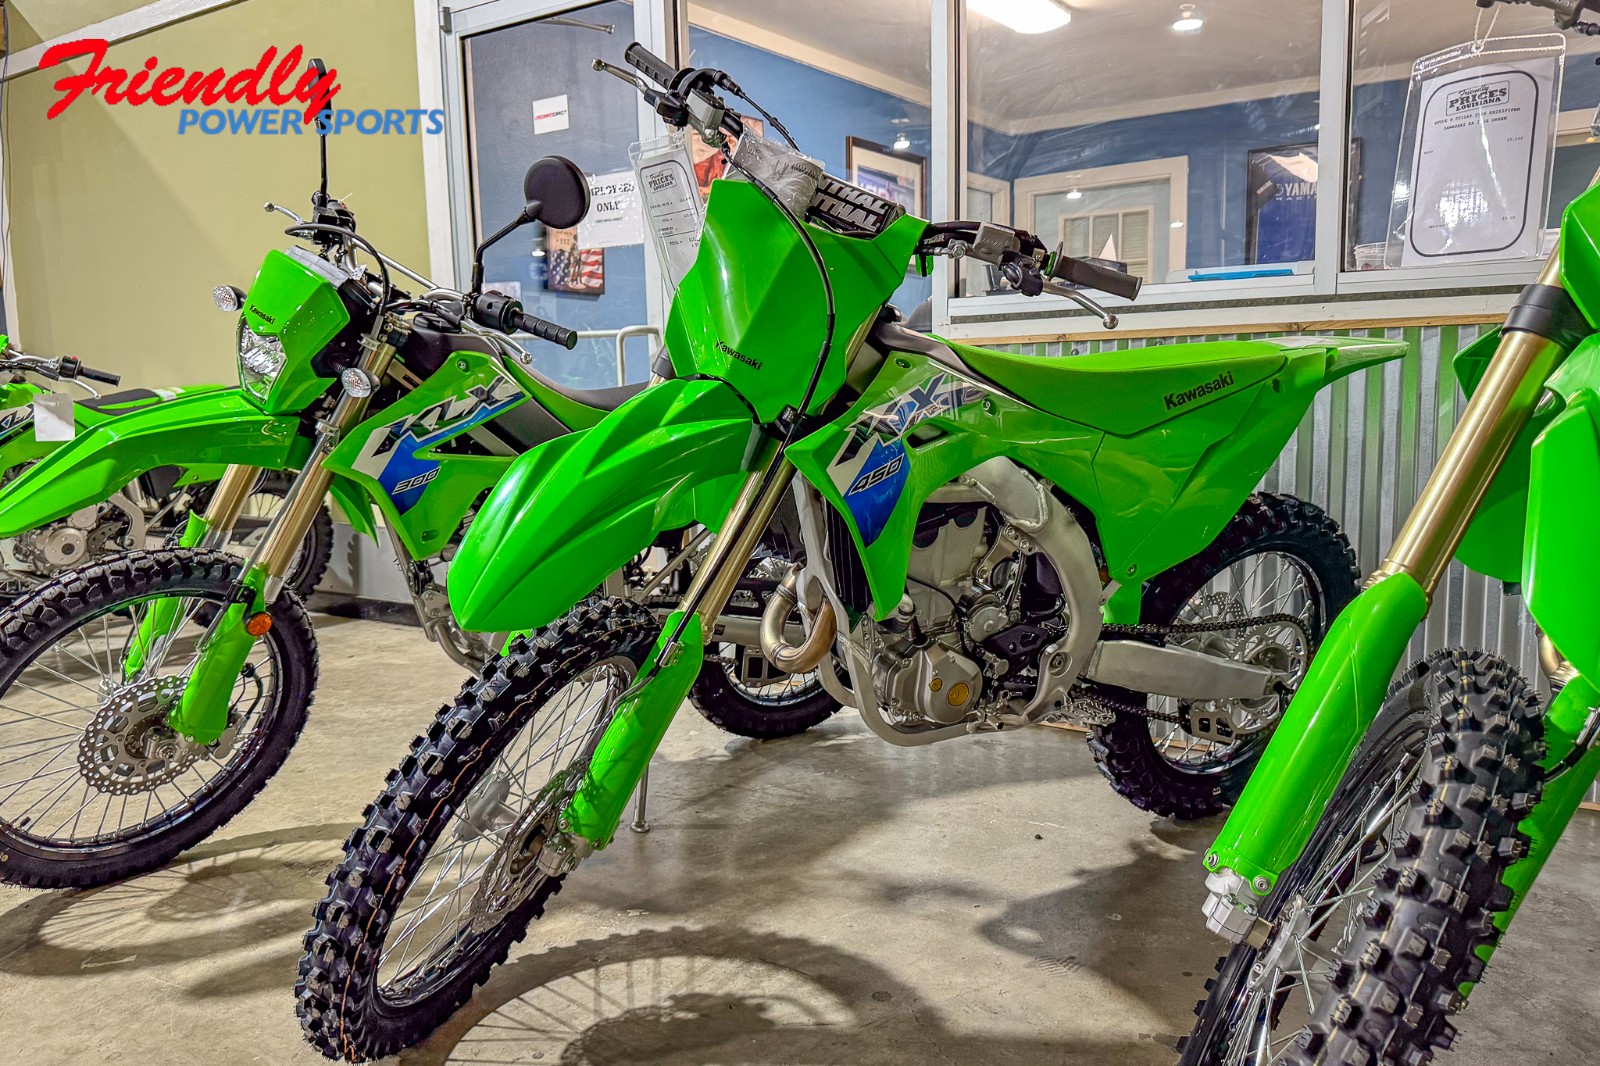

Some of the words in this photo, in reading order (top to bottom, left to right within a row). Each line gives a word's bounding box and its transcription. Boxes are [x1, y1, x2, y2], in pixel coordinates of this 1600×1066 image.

[1448, 88, 1507, 109] PRICES
[1456, 97, 1501, 112] LOUISIANA
[648, 174, 674, 188] PRICES
[1284, 182, 1317, 196] YAMA
[596, 200, 621, 213] ONLY
[249, 304, 276, 325] Kawasaki
[716, 340, 763, 370] Kawasaki
[1163, 370, 1235, 411] Kawasaki
[392, 466, 441, 495] 300
[849, 453, 904, 496] 450
